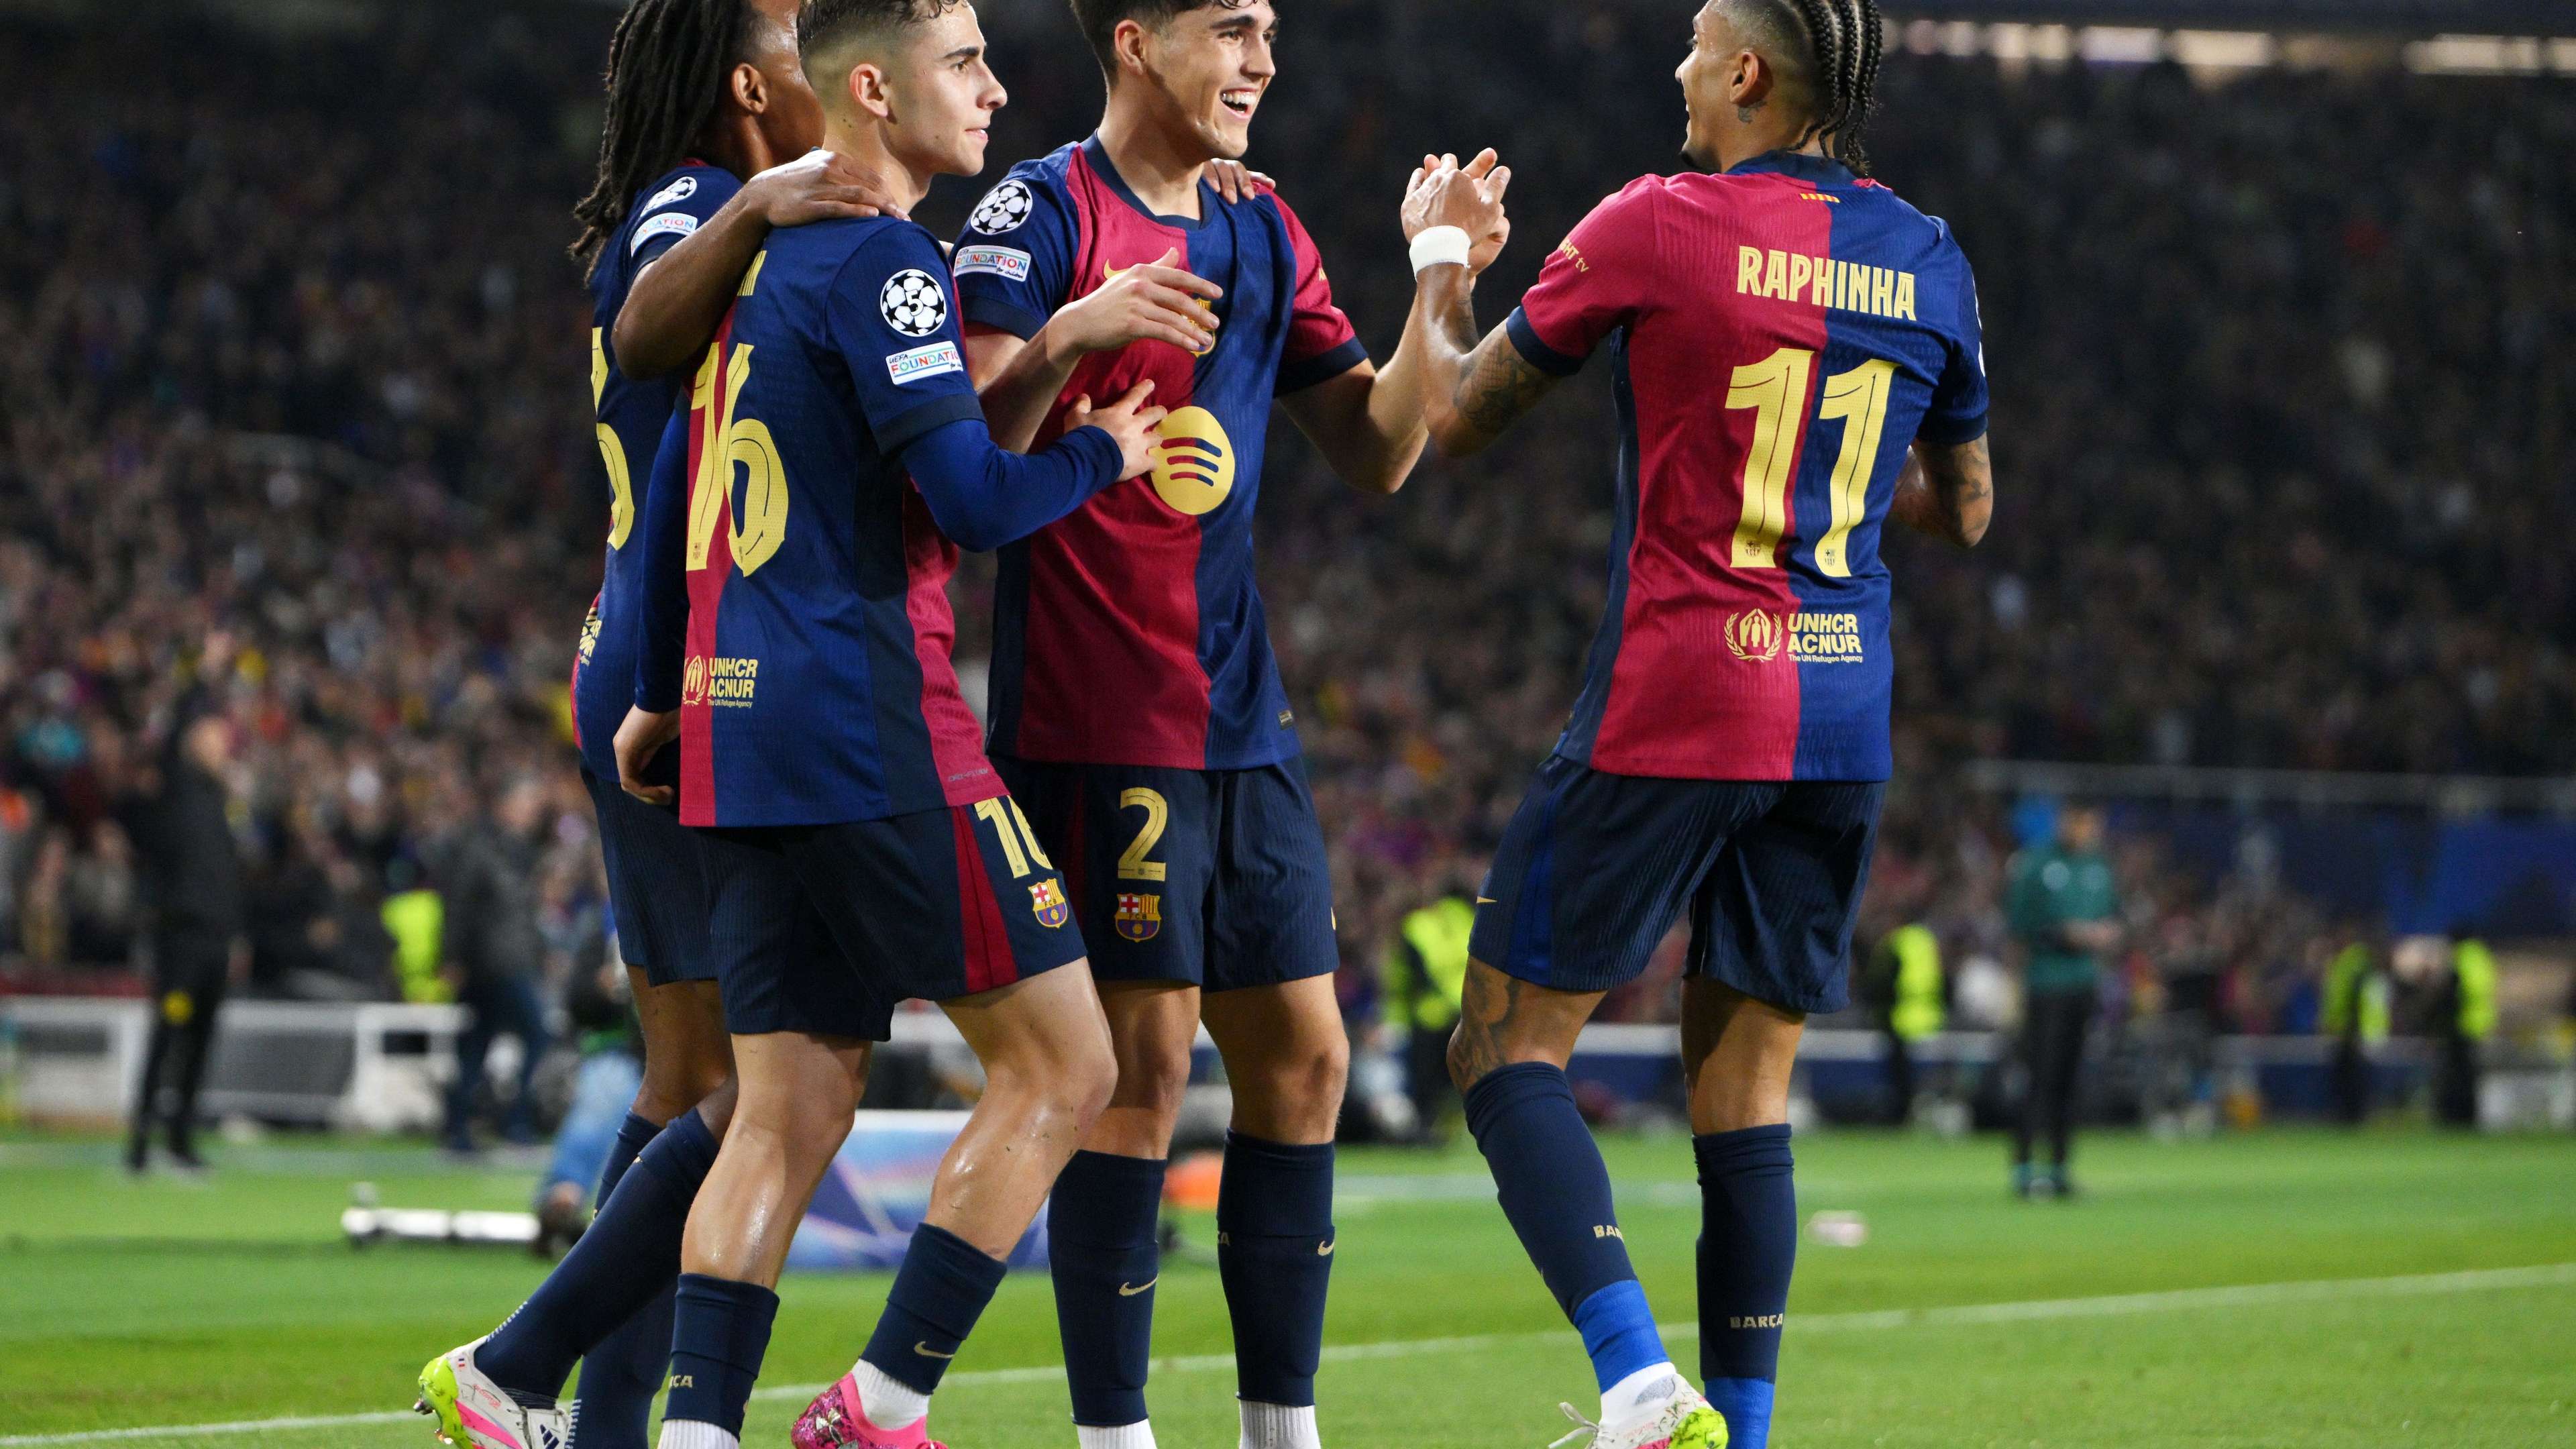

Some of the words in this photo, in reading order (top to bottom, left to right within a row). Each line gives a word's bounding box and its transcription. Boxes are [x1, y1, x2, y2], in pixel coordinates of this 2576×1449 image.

[957, 254, 1026, 271] FOUNDATION
[1736, 245, 1917, 321] RAPHINHA
[906, 289, 924, 317] 5
[889, 354, 908, 364] UEFA
[1725, 347, 1902, 577] 11
[1787, 613, 1858, 633] UNHCR
[1787, 633, 1862, 654] ACNUR
[709, 657, 758, 678] UNHCR
[1812, 655, 1839, 664] Refugee
[1840, 655, 1863, 663] Agency
[707, 678, 755, 698] ACNUR
[1118, 787, 1168, 881] 2
[1729, 1313, 1783, 1329] BARÇA
